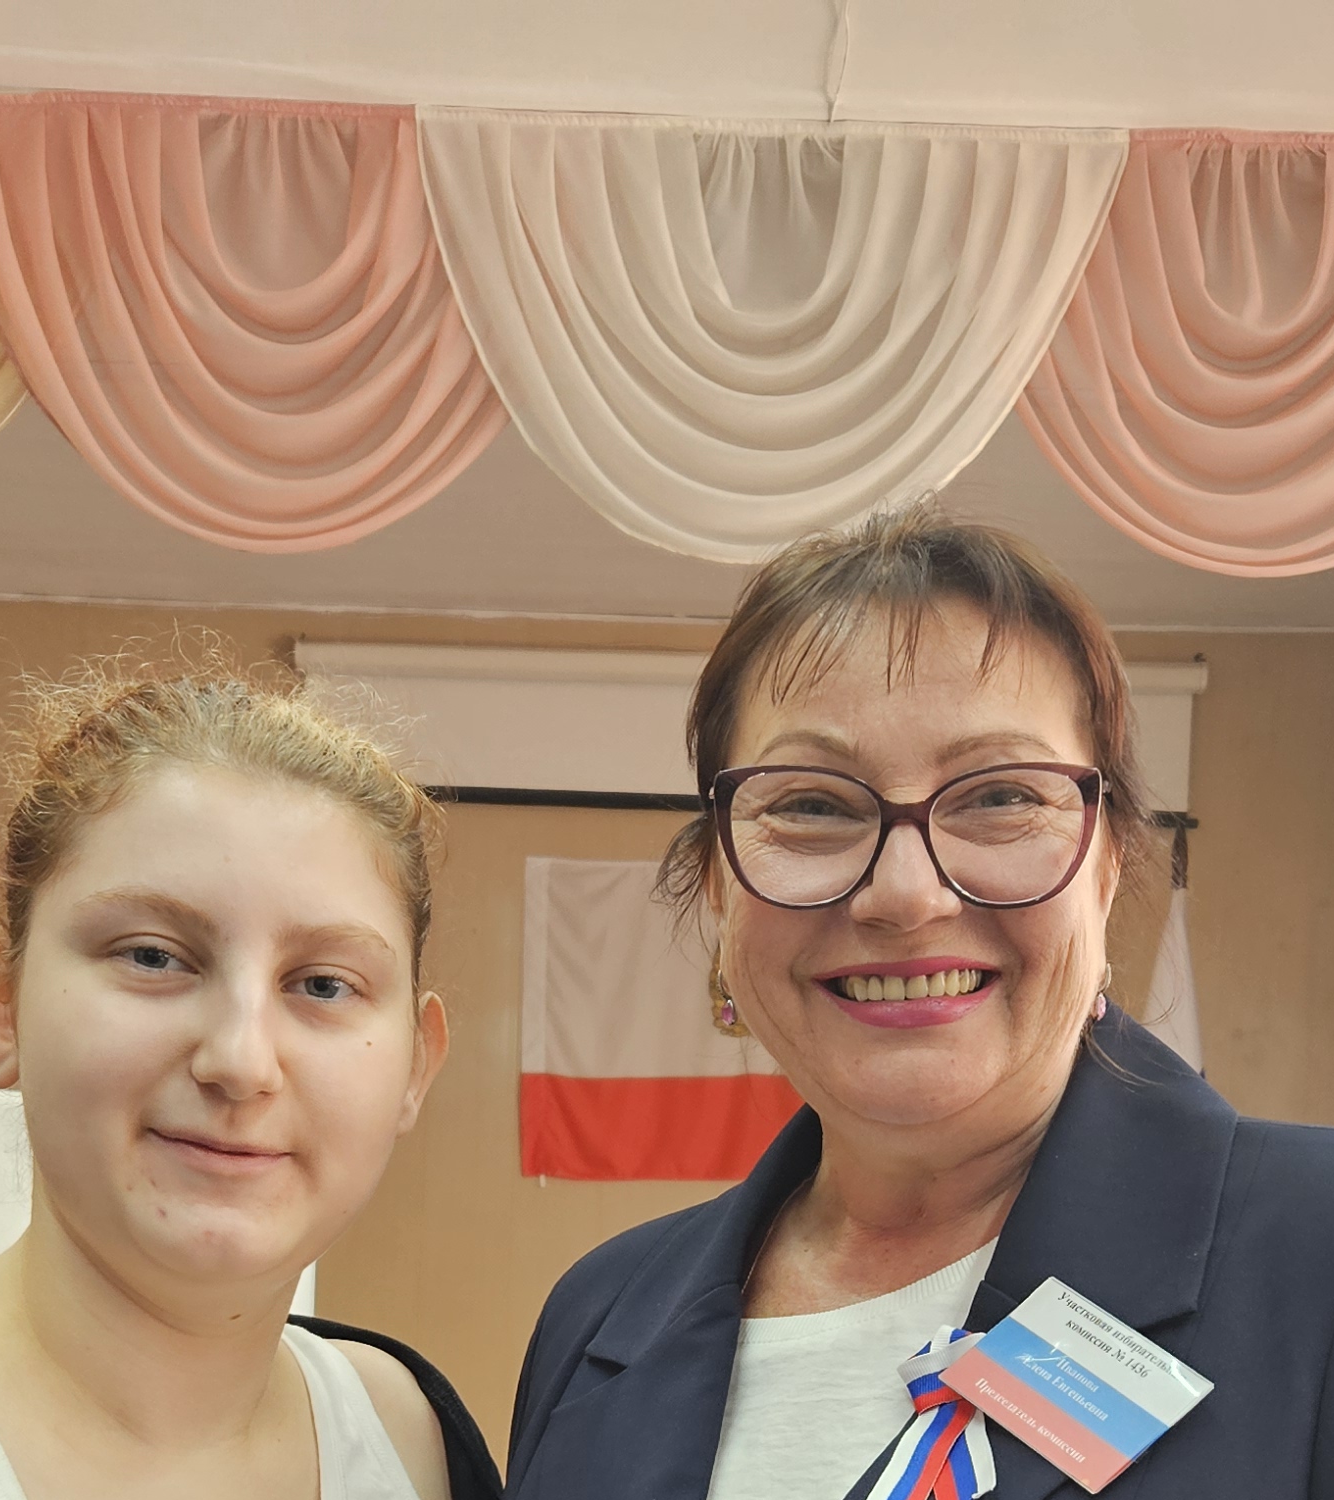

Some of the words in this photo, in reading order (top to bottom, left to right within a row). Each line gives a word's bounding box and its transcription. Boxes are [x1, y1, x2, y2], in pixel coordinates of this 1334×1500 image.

[1058, 1291, 1113, 1333] Участковая
[1112, 1330, 1181, 1380] избирательн
[1066, 1320, 1112, 1354] комиссия
[1111, 1349, 1126, 1362] №
[1125, 1358, 1154, 1379] 1436
[1056, 1358, 1100, 1393] Иванова
[975, 1378, 1037, 1428] Председатель
[1037, 1425, 1086, 1463] комиссии
